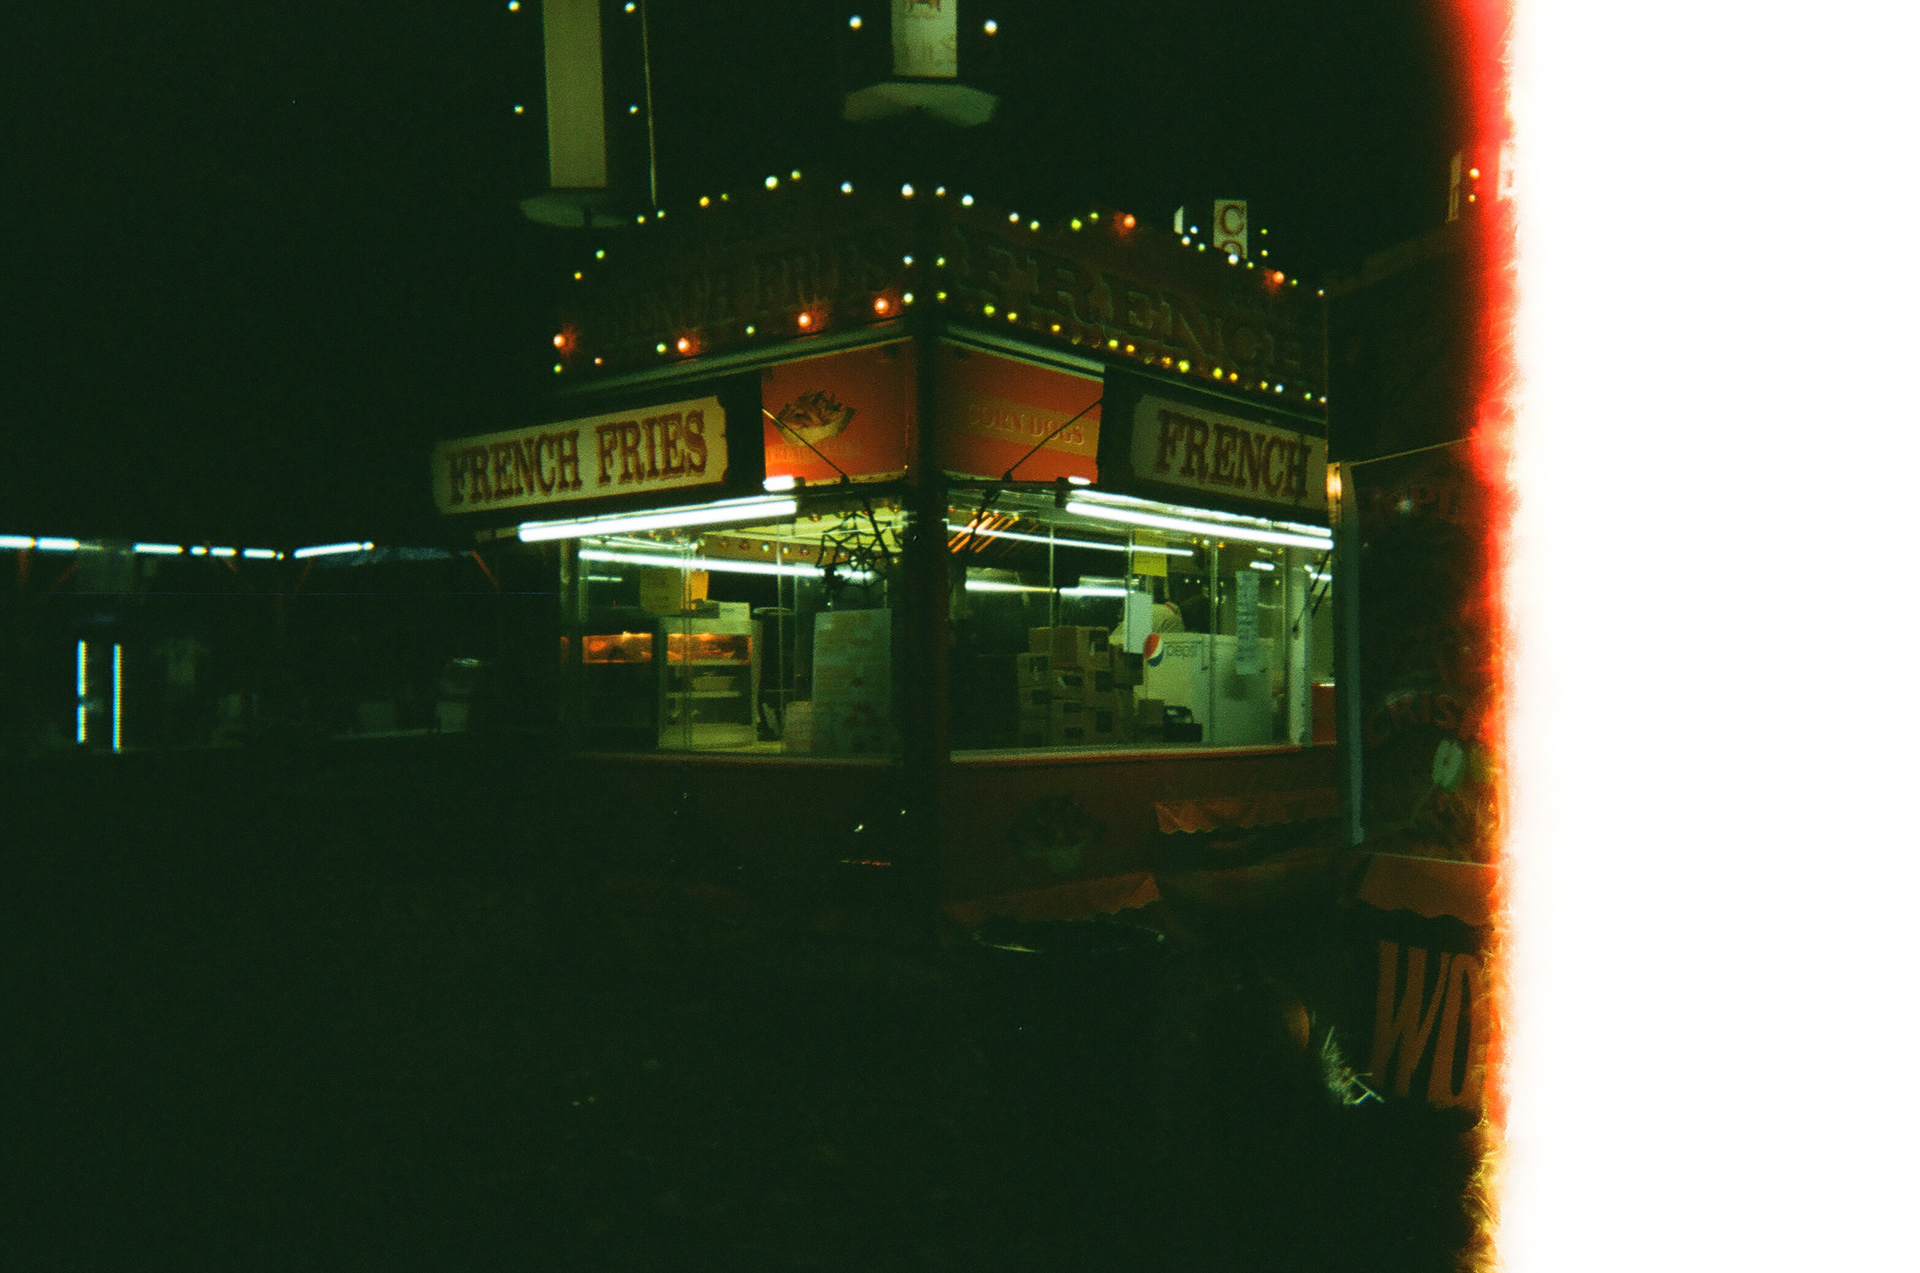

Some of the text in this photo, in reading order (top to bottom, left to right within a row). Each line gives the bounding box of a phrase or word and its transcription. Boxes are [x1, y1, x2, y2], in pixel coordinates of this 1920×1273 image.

[954, 224, 1312, 386] FRENCH
[445, 409, 708, 506] FRENCH FRIES
[1154, 408, 1313, 500] FRENCH
